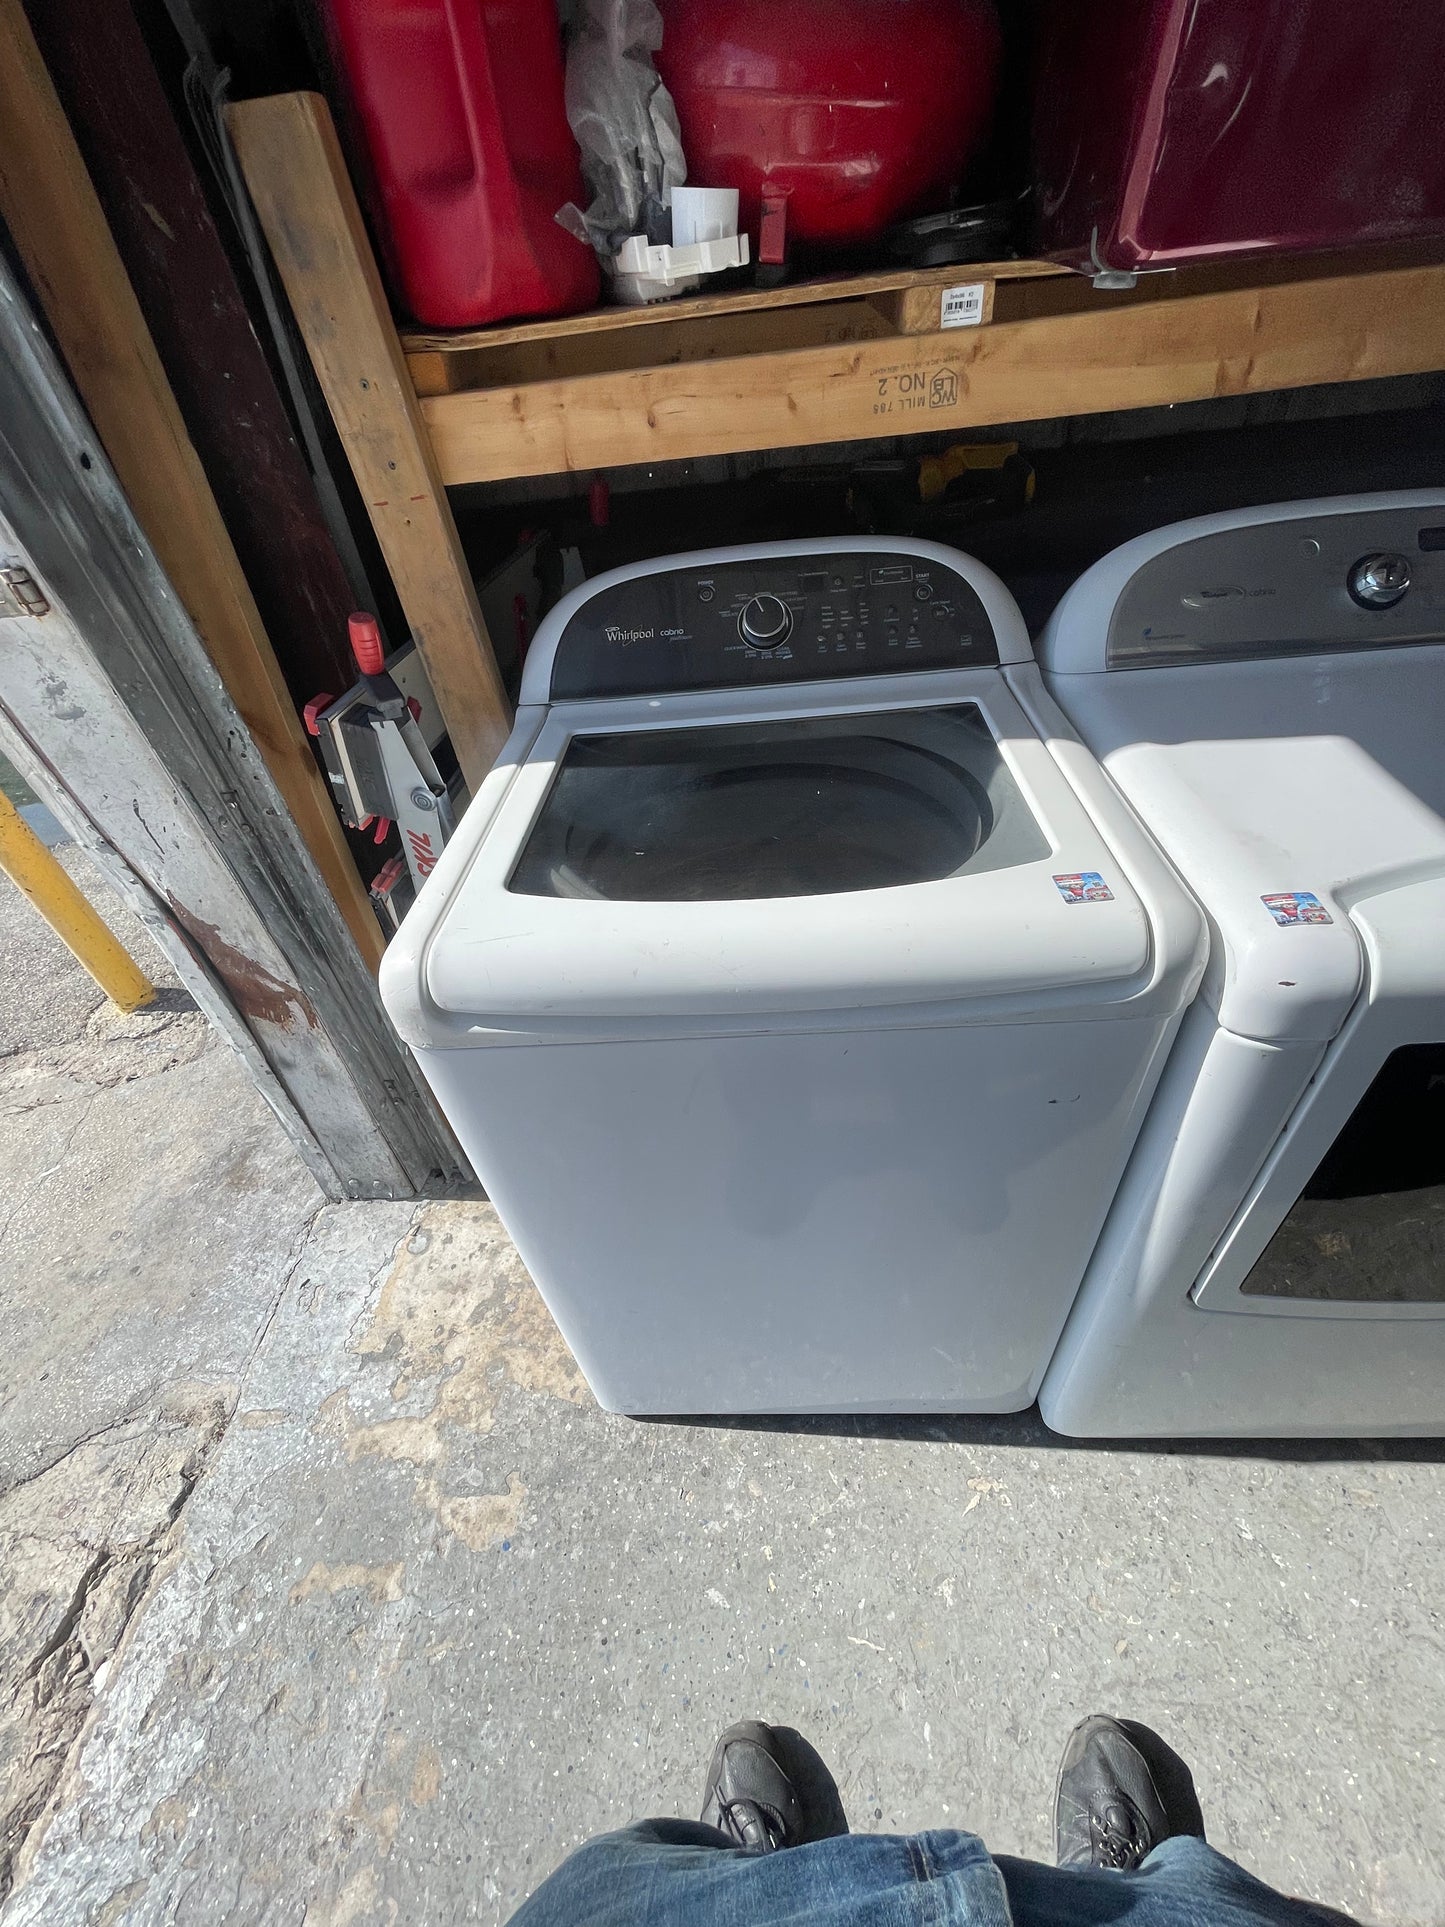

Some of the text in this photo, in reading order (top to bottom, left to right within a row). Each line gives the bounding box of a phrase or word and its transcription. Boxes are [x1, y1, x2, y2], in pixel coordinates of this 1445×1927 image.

[878, 371, 926, 396] NO. 2
[900, 395, 926, 409] MILL
[606, 628, 654, 642] Whirlpool
[406, 829, 439, 877] SKIL
